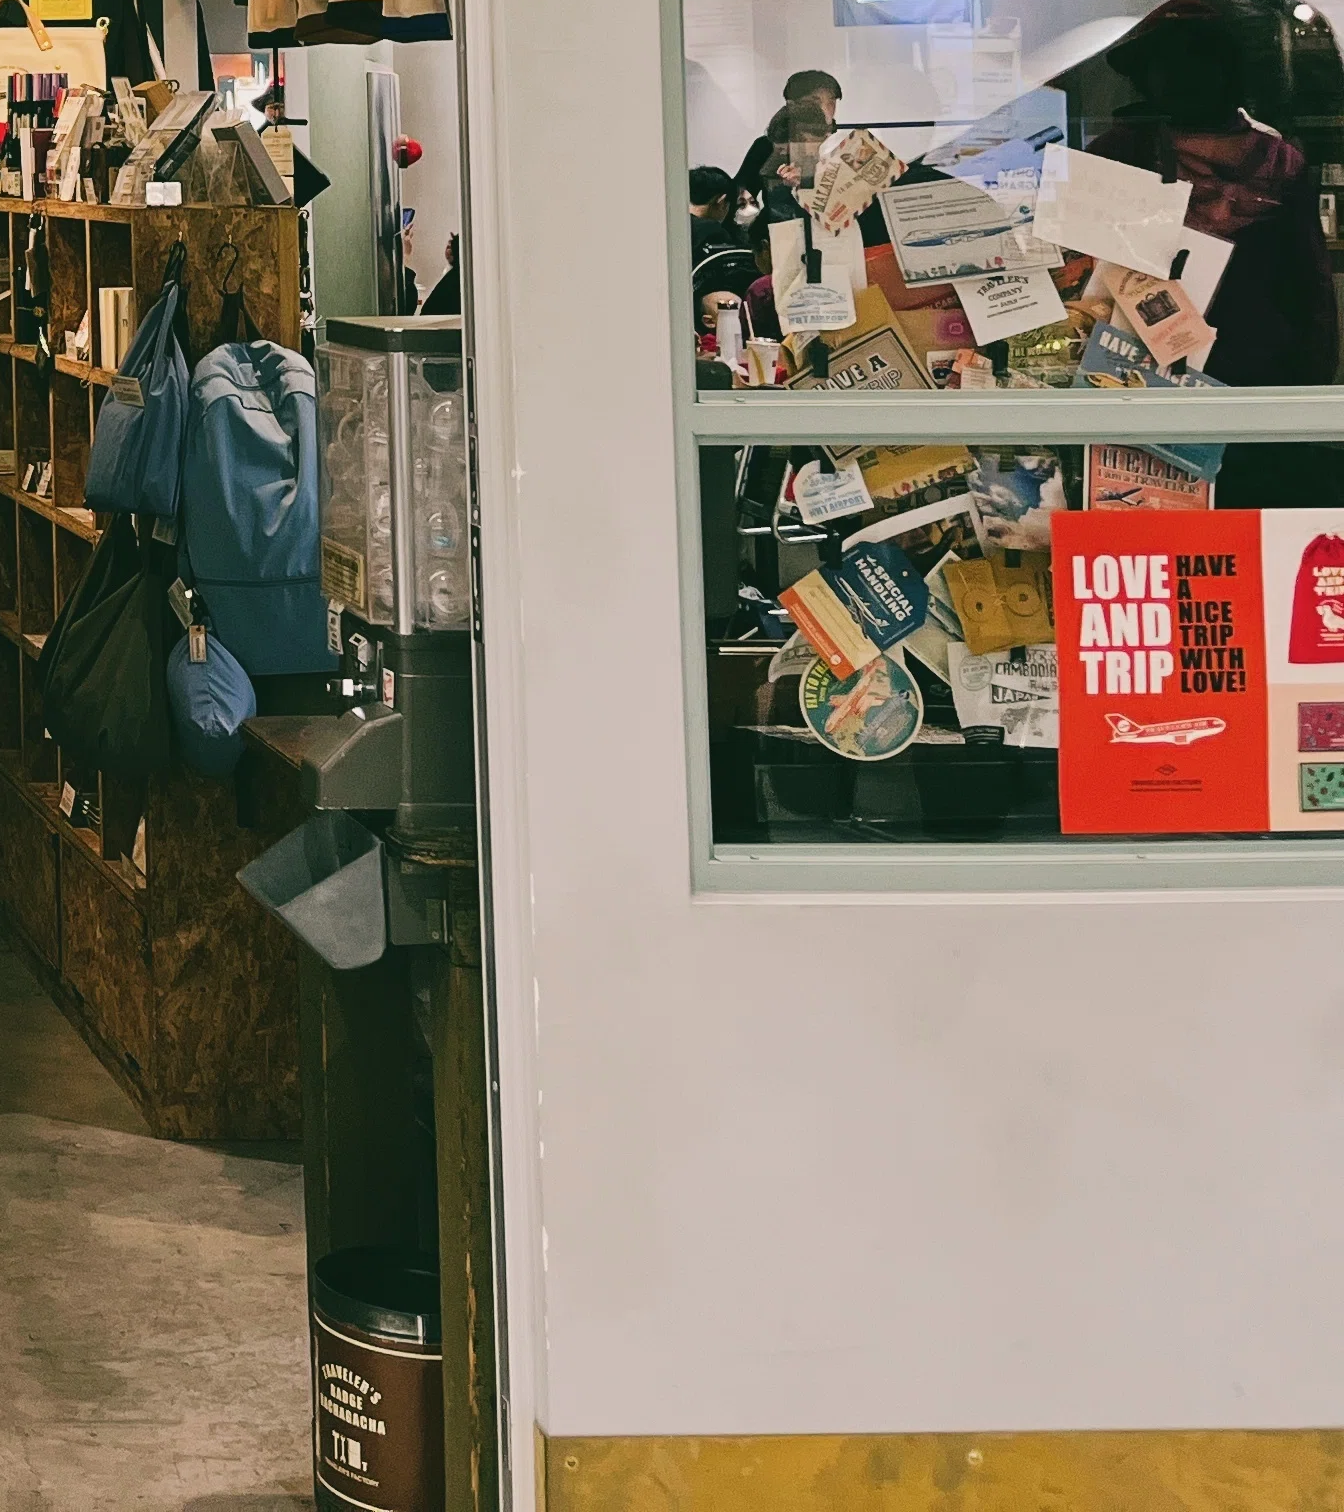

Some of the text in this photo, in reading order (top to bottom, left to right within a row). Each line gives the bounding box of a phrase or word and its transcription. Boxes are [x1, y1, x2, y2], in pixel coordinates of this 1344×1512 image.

[988, 286, 1023, 301] COMPANY
[1099, 330, 1139, 362] HAVE
[869, 353, 887, 373] A
[1072, 555, 1170, 600] LOVE
[1176, 555, 1236, 577] HAVE
[855, 558, 908, 622] HANDLING
[875, 566, 913, 616] SPECIAL
[1176, 579, 1193, 600] A
[1177, 601, 1233, 624] NICE
[1079, 603, 1172, 647] AND
[1178, 624, 1234, 647] TRIP
[1180, 648, 1244, 670] WITH
[1079, 651, 1174, 695] TRIP
[1180, 671, 1247, 693] LOVE!
[993, 688, 1038, 703] JAPAN
[322, 1364, 382, 1404] TRAVELER'S
[320, 1392, 386, 1436] GACHAGACHA
